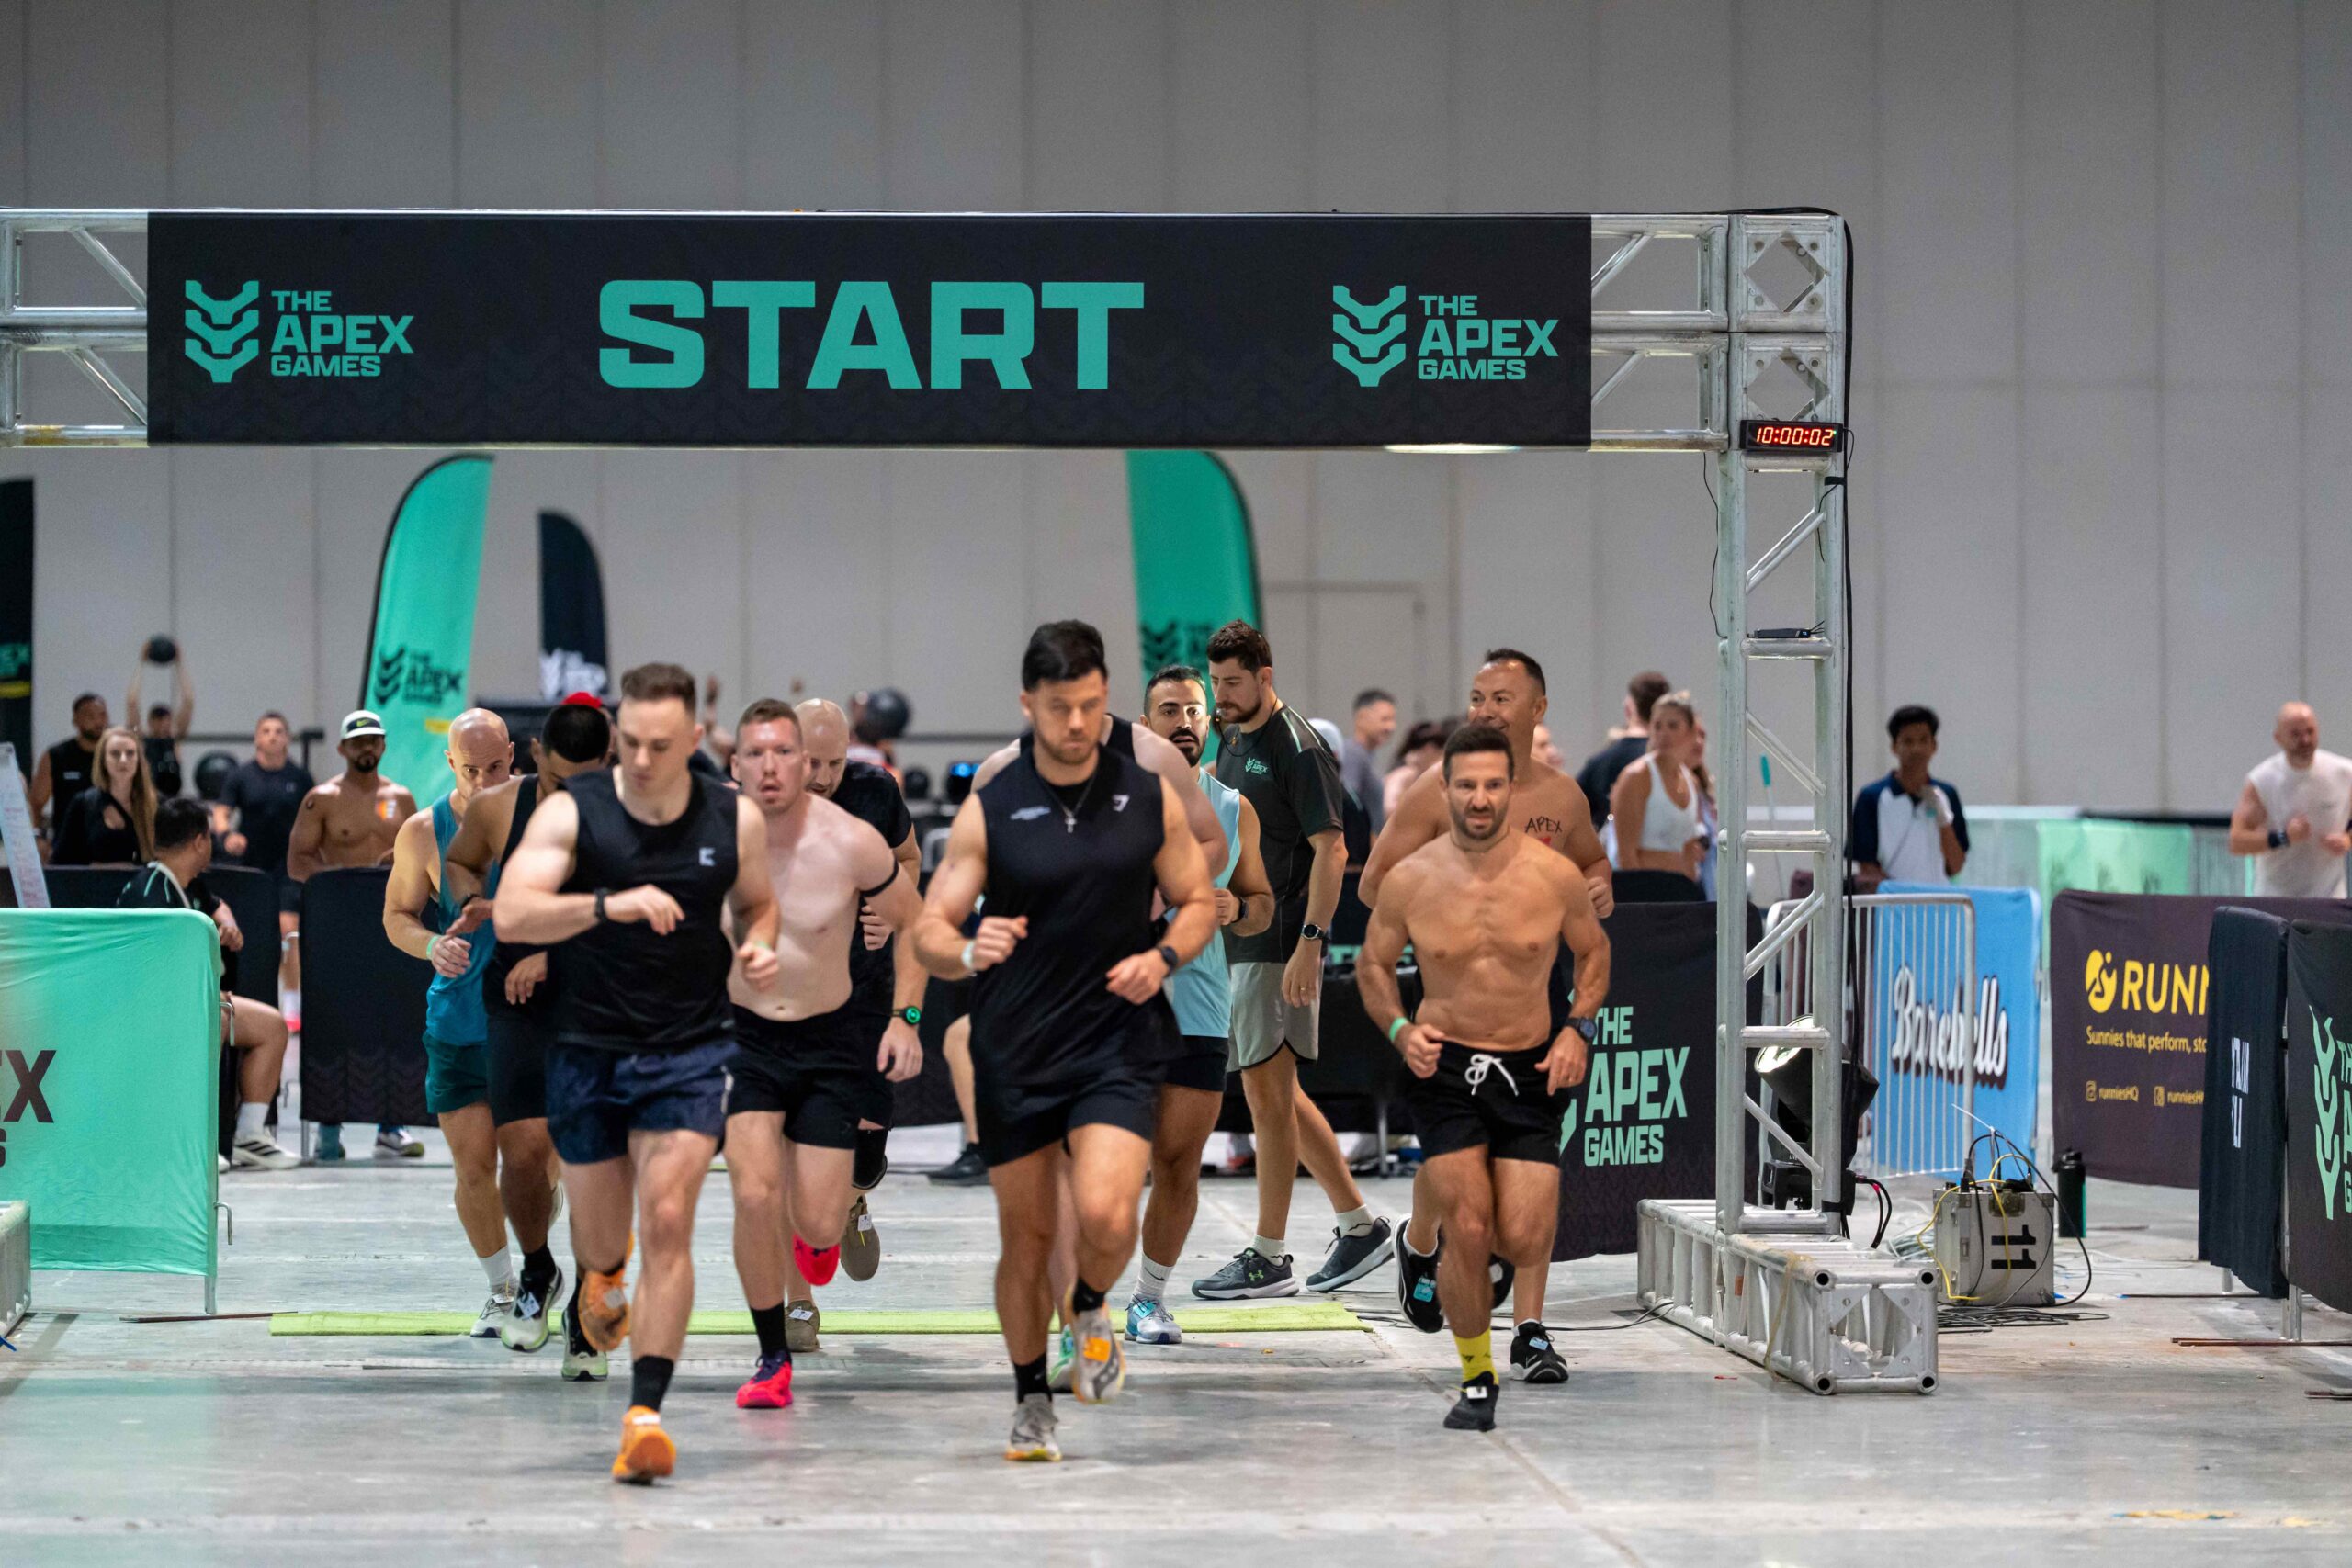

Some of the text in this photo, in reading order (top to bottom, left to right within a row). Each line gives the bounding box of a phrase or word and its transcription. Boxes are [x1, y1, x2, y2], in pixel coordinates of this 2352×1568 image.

[271, 290, 332, 311] THE
[1418, 295, 1478, 316] THE
[270, 314, 414, 354] APEX
[599, 279, 1145, 389] START
[1417, 319, 1559, 357] APEX
[270, 355, 381, 377] GAMES
[1418, 358, 1527, 380] GAMES
[1756, 426, 1834, 446] 10:00:02
[1525, 816, 1563, 834] APEX
[1592, 1006, 1634, 1045] THE
[1892, 965, 2008, 1089] Bareblls
[2086, 1025, 2125, 1049] Sunnies
[2125, 1029, 2147, 1050] that
[2148, 1032, 2192, 1055] perform,
[1584, 1046, 1690, 1122] APEX
[1584, 1124, 1664, 1167] GAMES
[1991, 1224, 2037, 1269] 11
